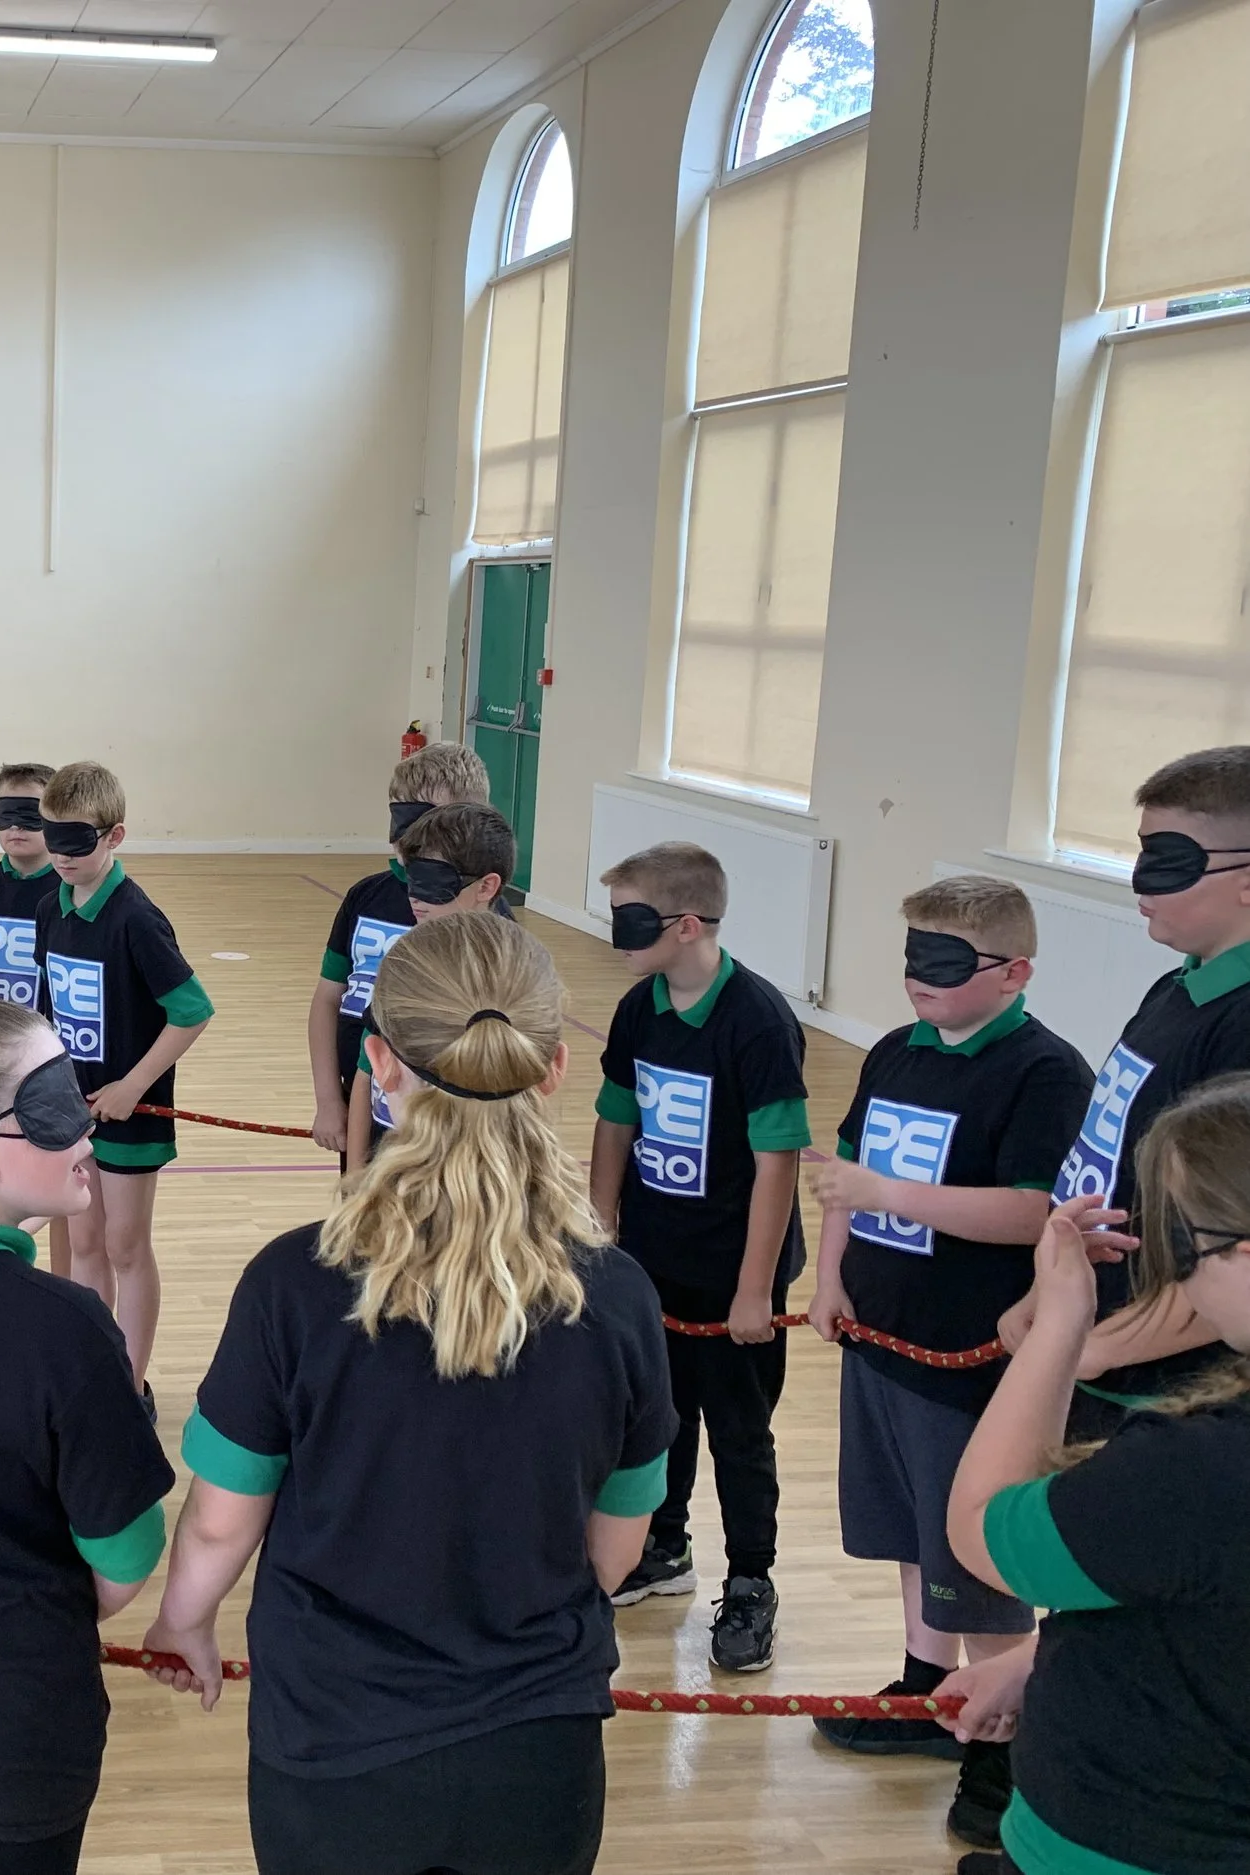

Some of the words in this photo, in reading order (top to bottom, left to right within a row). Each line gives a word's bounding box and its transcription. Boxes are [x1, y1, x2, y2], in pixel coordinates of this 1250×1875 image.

[356, 926, 403, 967] P
[50, 961, 99, 1013] PE
[862, 1110, 946, 1184] PE
